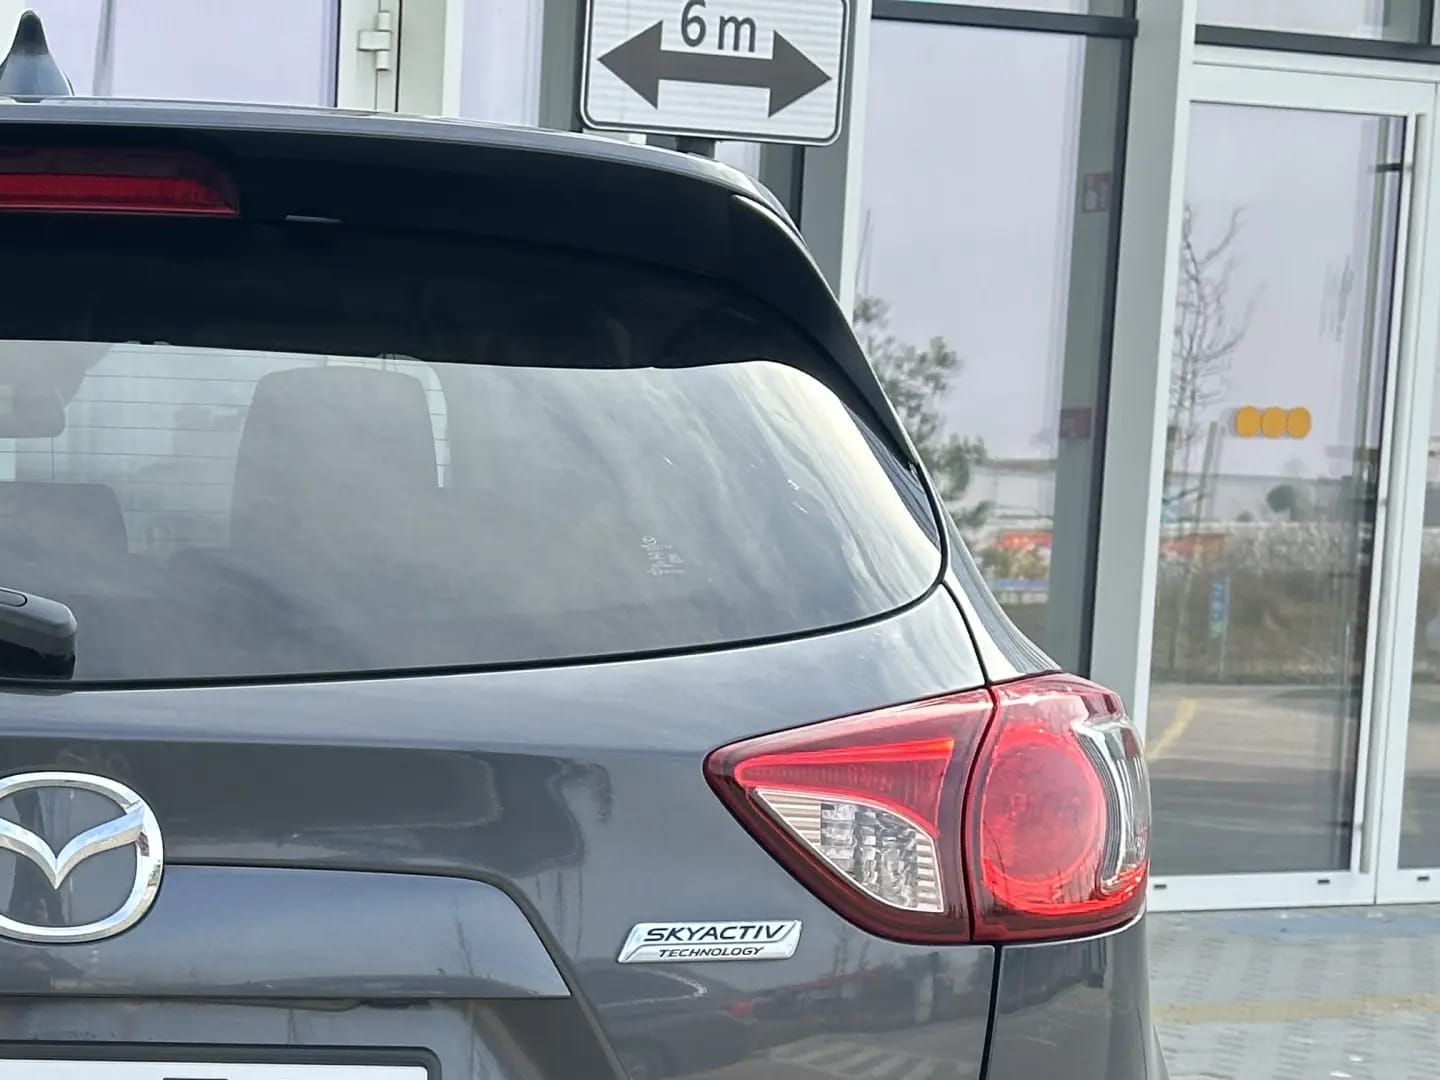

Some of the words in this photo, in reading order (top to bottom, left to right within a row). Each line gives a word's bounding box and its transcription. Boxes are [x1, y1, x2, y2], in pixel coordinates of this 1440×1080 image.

[680, 0, 707, 48] 6
[717, 15, 757, 53] m
[643, 924, 787, 942] SKYACTIV
[659, 946, 765, 958] TECHNOLOGY
